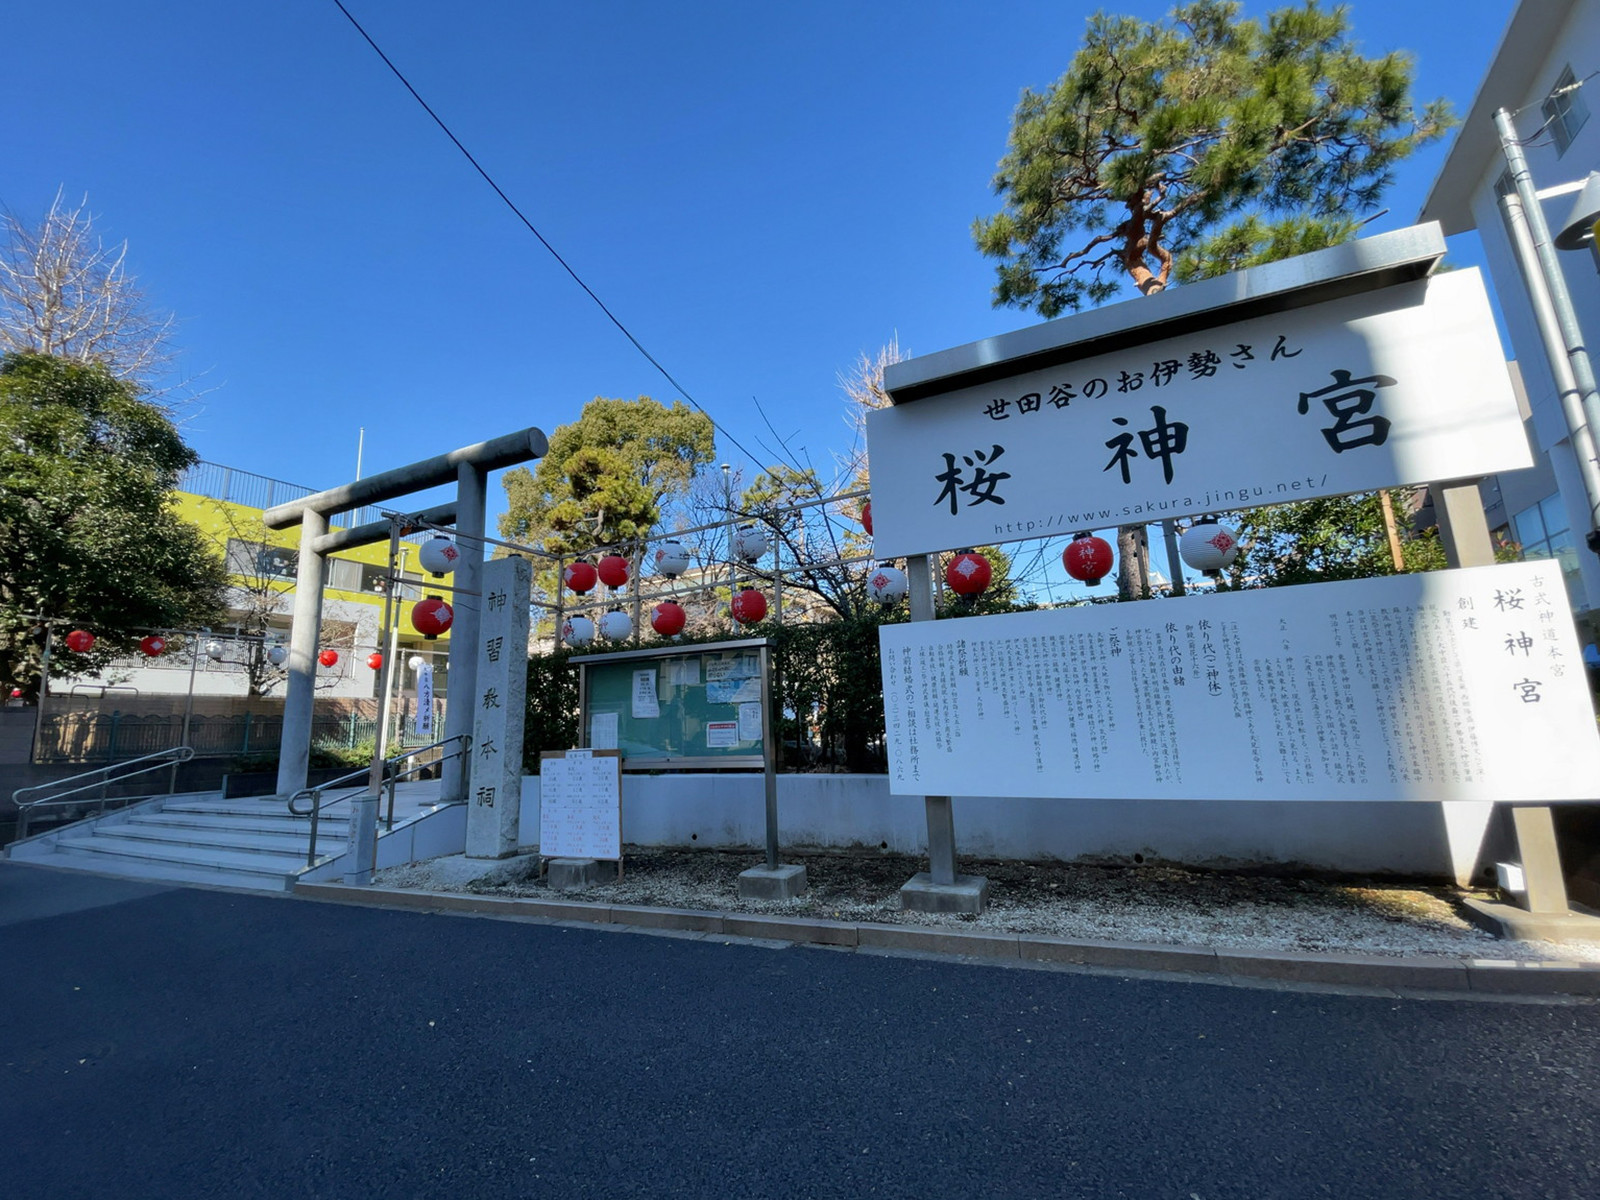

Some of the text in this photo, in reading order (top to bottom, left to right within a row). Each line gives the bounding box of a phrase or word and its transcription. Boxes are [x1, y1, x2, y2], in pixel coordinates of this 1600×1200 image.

[983, 335, 1303, 421] 世田谷のお伊勢さん
[934, 369, 1399, 517] 桜神宮
[994, 473, 1328, 535] http://www.sakura.jingu.net/
[1109, 627, 1121, 656] ご祭神
[1458, 597, 1479, 631] 創建
[1494, 588, 1542, 704] 桜神宮
[1530, 575, 1565, 677] 古式神道本宮
[956, 640, 967, 676] 諸祭祈願
[1165, 622, 1185, 686] 依り代の由緒
[476, 588, 507, 808] 神習教本祠
